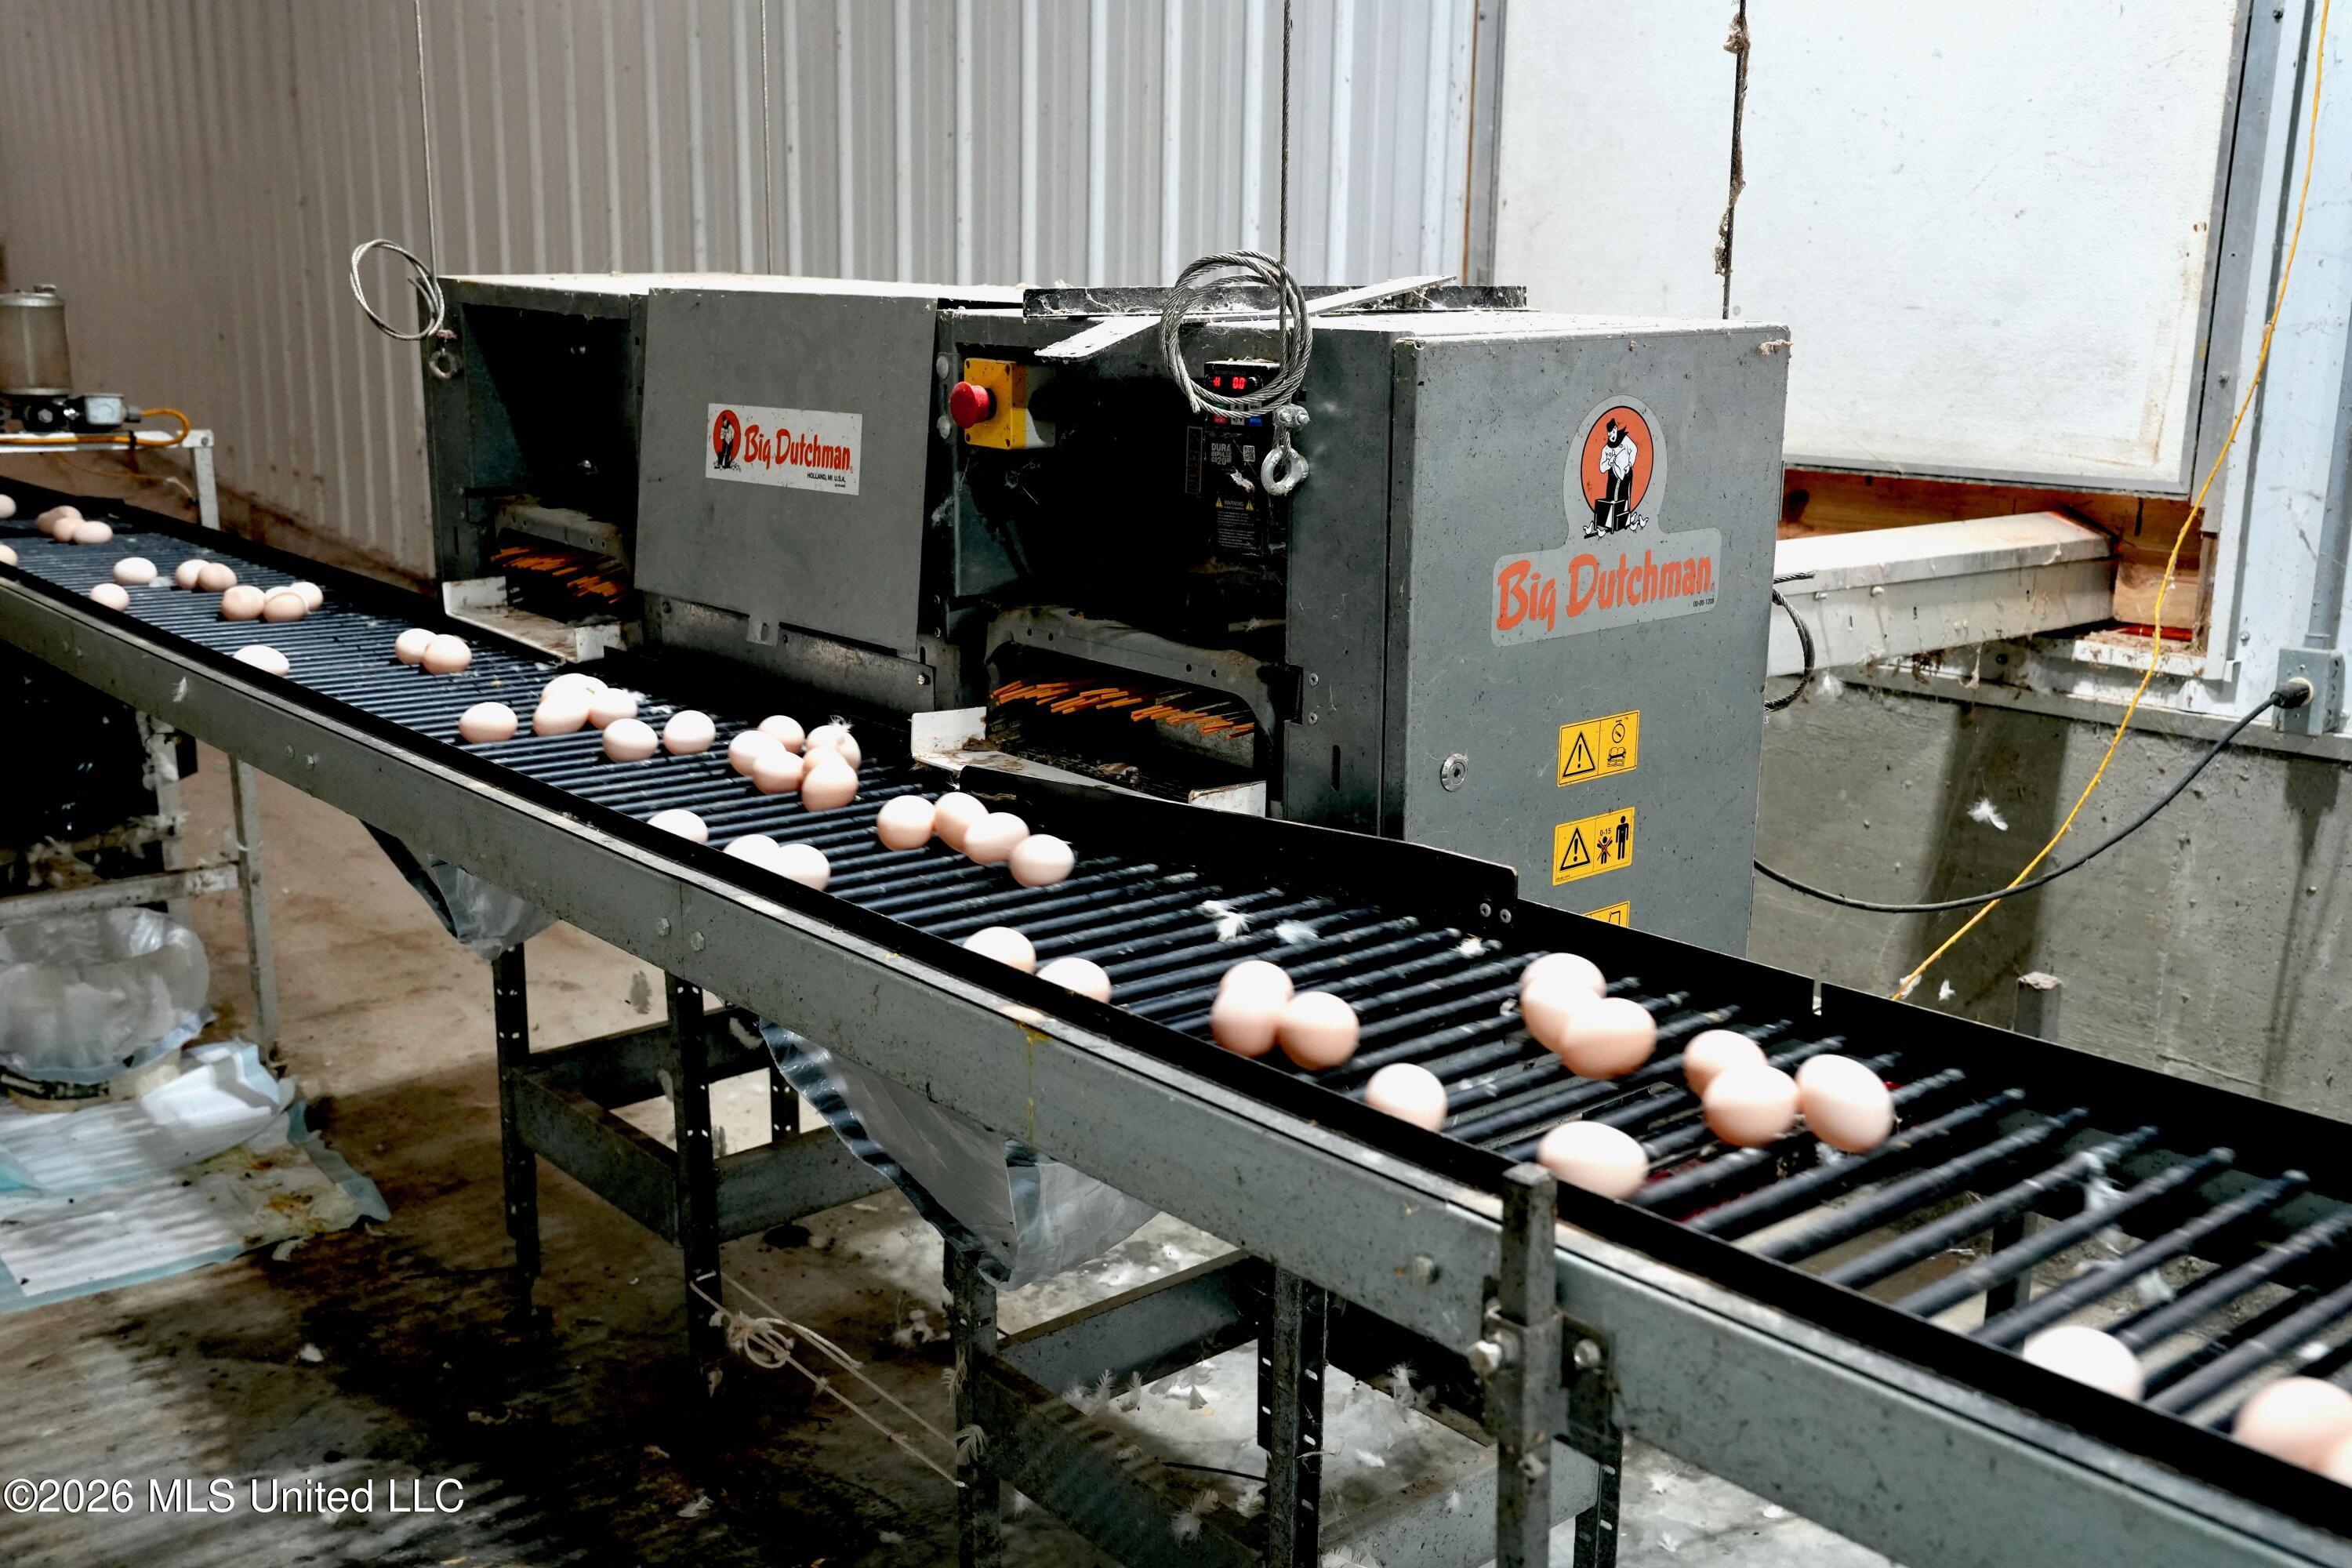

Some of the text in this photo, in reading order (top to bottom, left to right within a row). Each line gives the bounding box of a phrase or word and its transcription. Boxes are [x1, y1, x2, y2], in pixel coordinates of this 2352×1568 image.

[744, 424, 851, 470] Big Dutchman
[1211, 442, 1232, 452] DURA
[807, 472, 827, 481] HOLLAND,
[1496, 549, 1712, 632] Big Dutchman
[1599, 827, 1612, 837] 0-15
